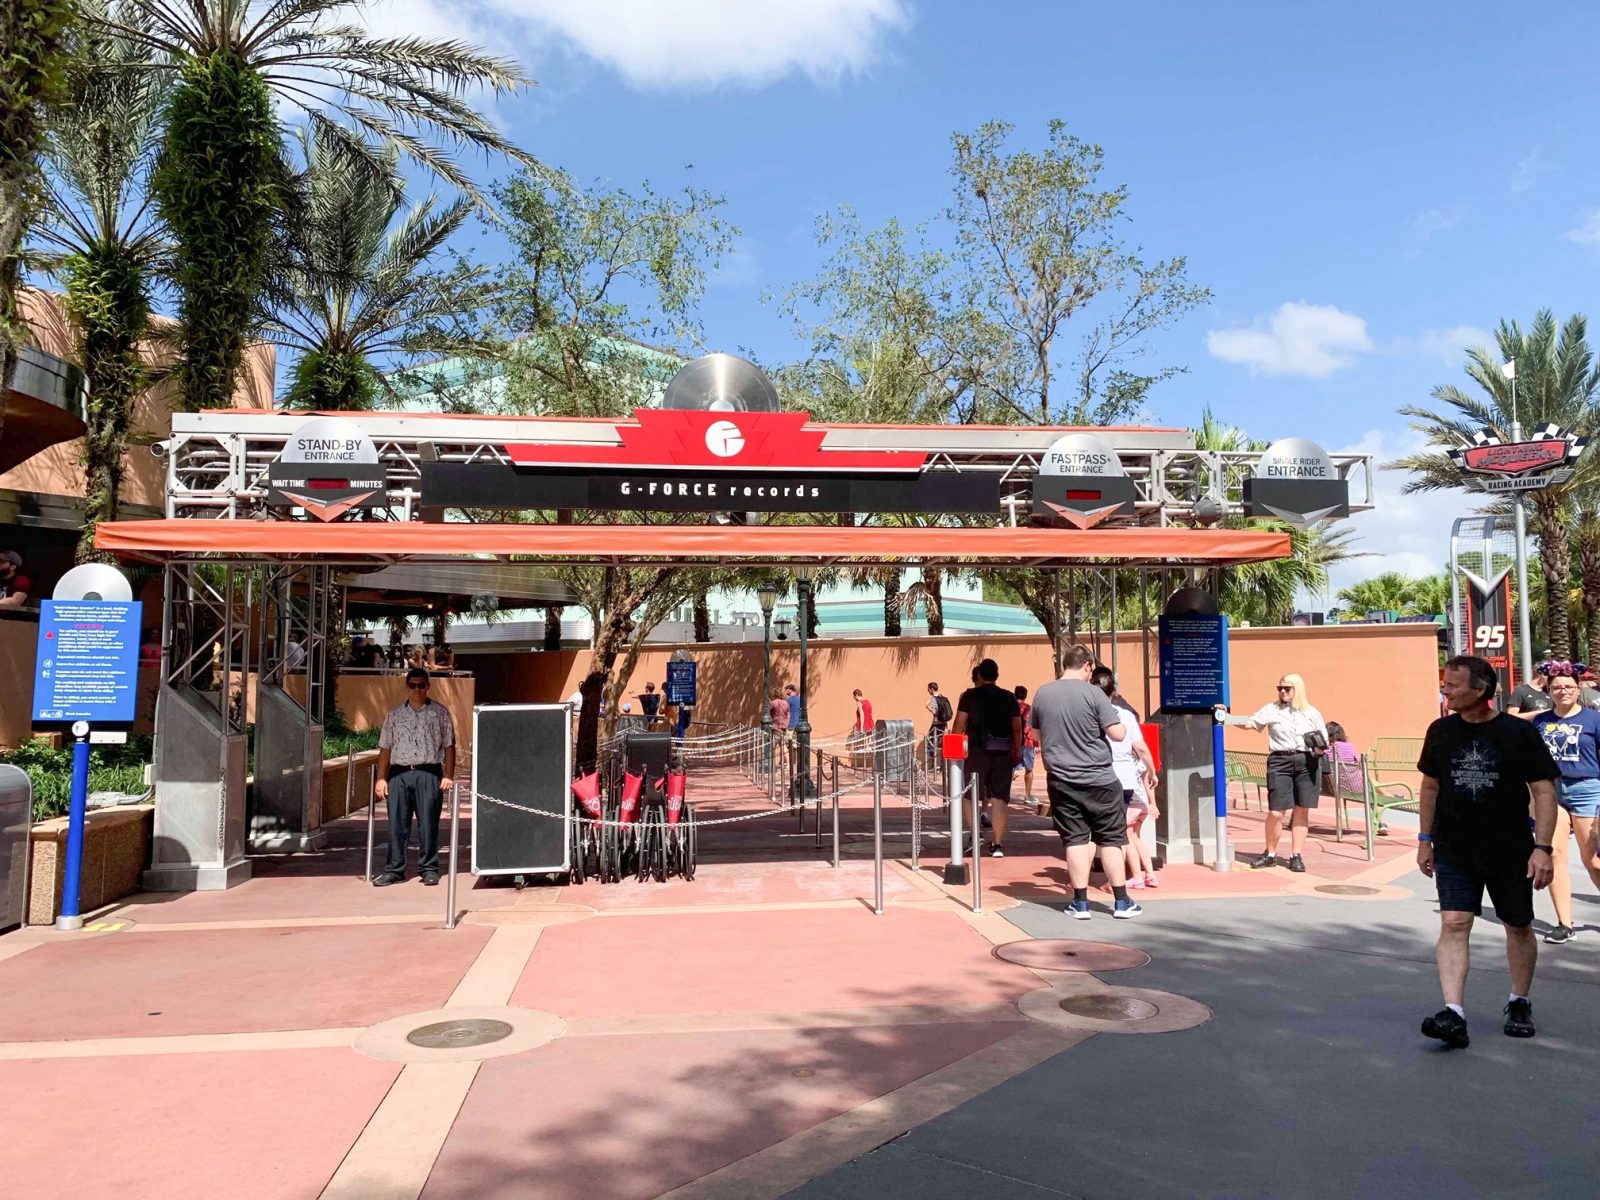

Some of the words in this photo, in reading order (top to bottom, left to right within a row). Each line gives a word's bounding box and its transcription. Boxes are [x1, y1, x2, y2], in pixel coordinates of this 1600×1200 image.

[298, 439, 362, 451] STAND-BY
[304, 452, 355, 460] ENTRANCE
[1272, 457, 1298, 465] SINGLE
[1059, 465, 1104, 474] ENTRANCE
[1267, 465, 1326, 477] ENTRANCE
[272, 479, 289, 487] WAIT
[289, 479, 306, 488] TIME
[350, 480, 383, 488] MINUTES
[1488, 481, 1513, 490] RACING
[1514, 478, 1547, 488] ACADEMY
[621, 482, 717, 495] G-FORCE
[730, 485, 820, 497] records
[1475, 625, 1506, 649] 95
